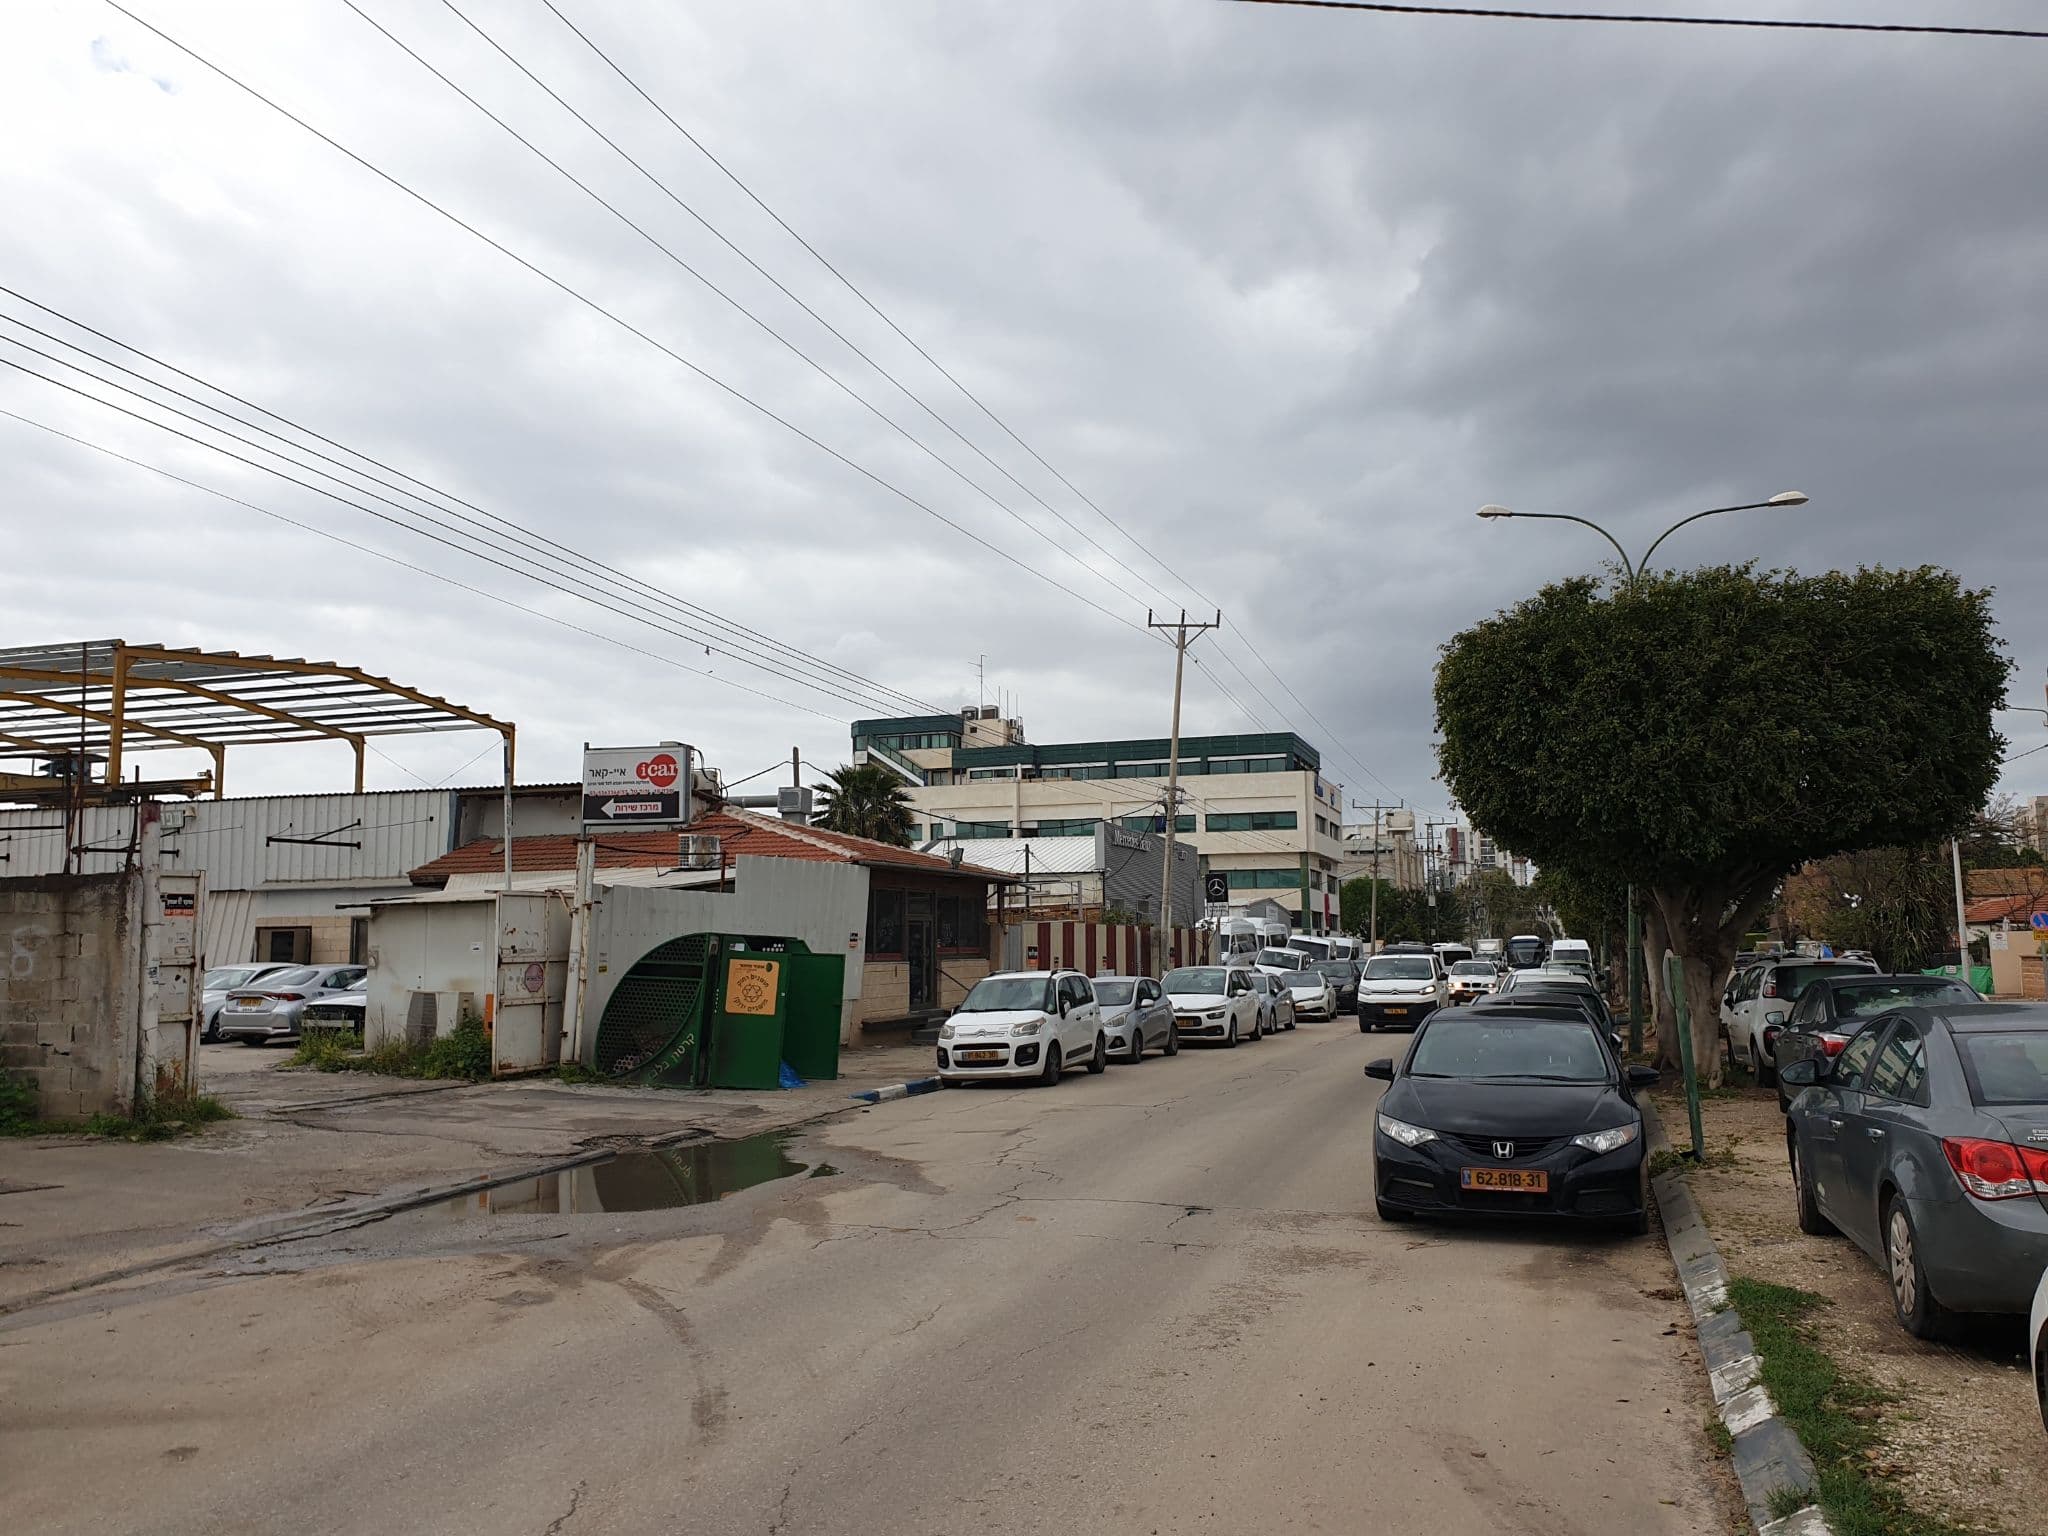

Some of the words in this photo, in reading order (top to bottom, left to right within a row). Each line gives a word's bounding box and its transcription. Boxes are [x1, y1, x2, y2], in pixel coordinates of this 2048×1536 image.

[614, 804, 638, 813] שירות
[640, 803, 659, 812] מרכז
[670, 1032, 696, 1064] קרטון
